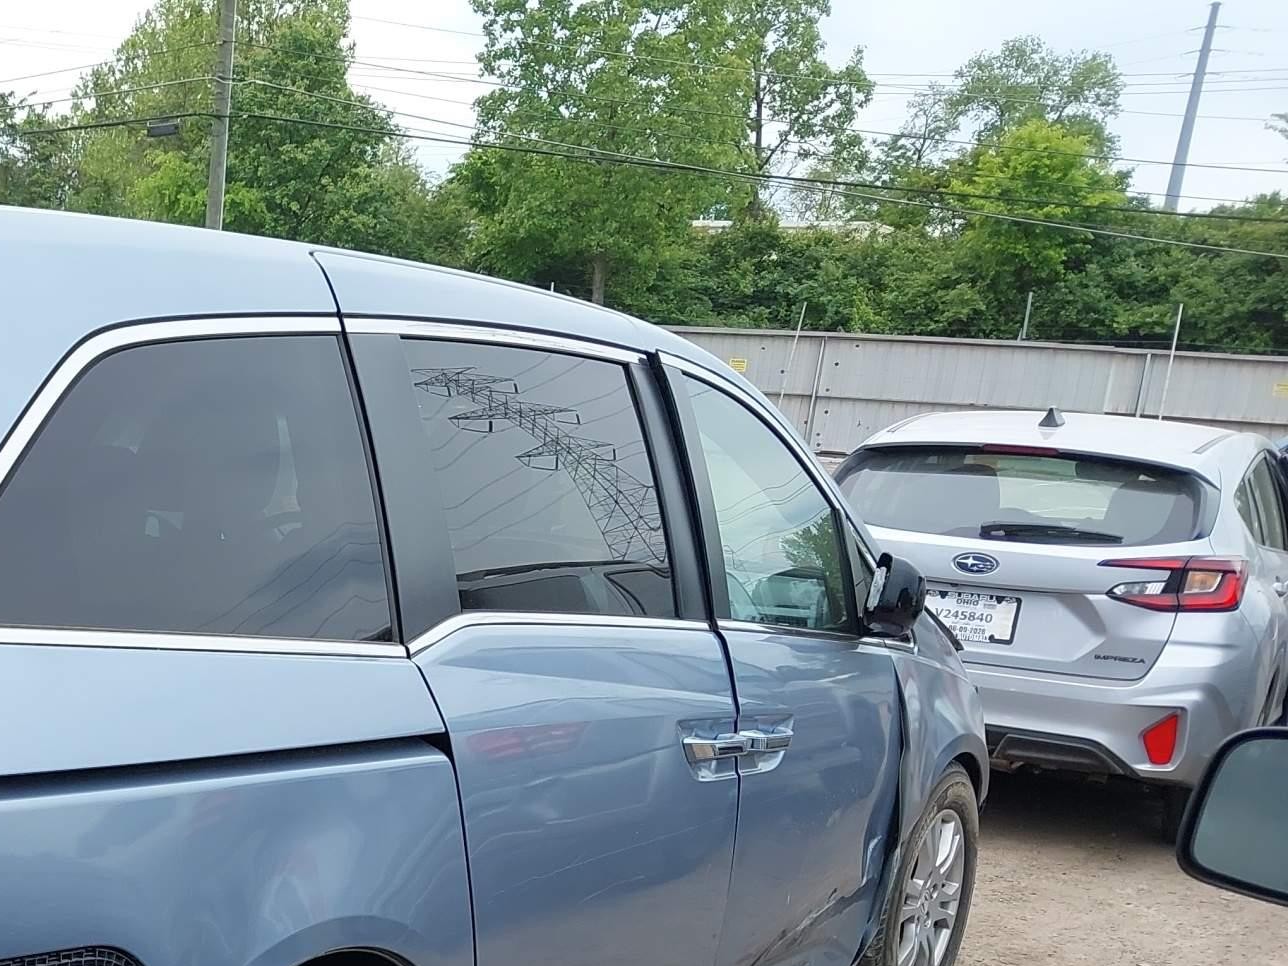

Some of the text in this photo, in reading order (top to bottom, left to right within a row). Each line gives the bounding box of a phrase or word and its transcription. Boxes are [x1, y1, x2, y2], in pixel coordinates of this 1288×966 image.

[948, 591, 996, 603] SUBARU
[956, 598, 979, 607] OHIO
[935, 607, 993, 623] V245840
[1094, 654, 1146, 665] IMPREZA
